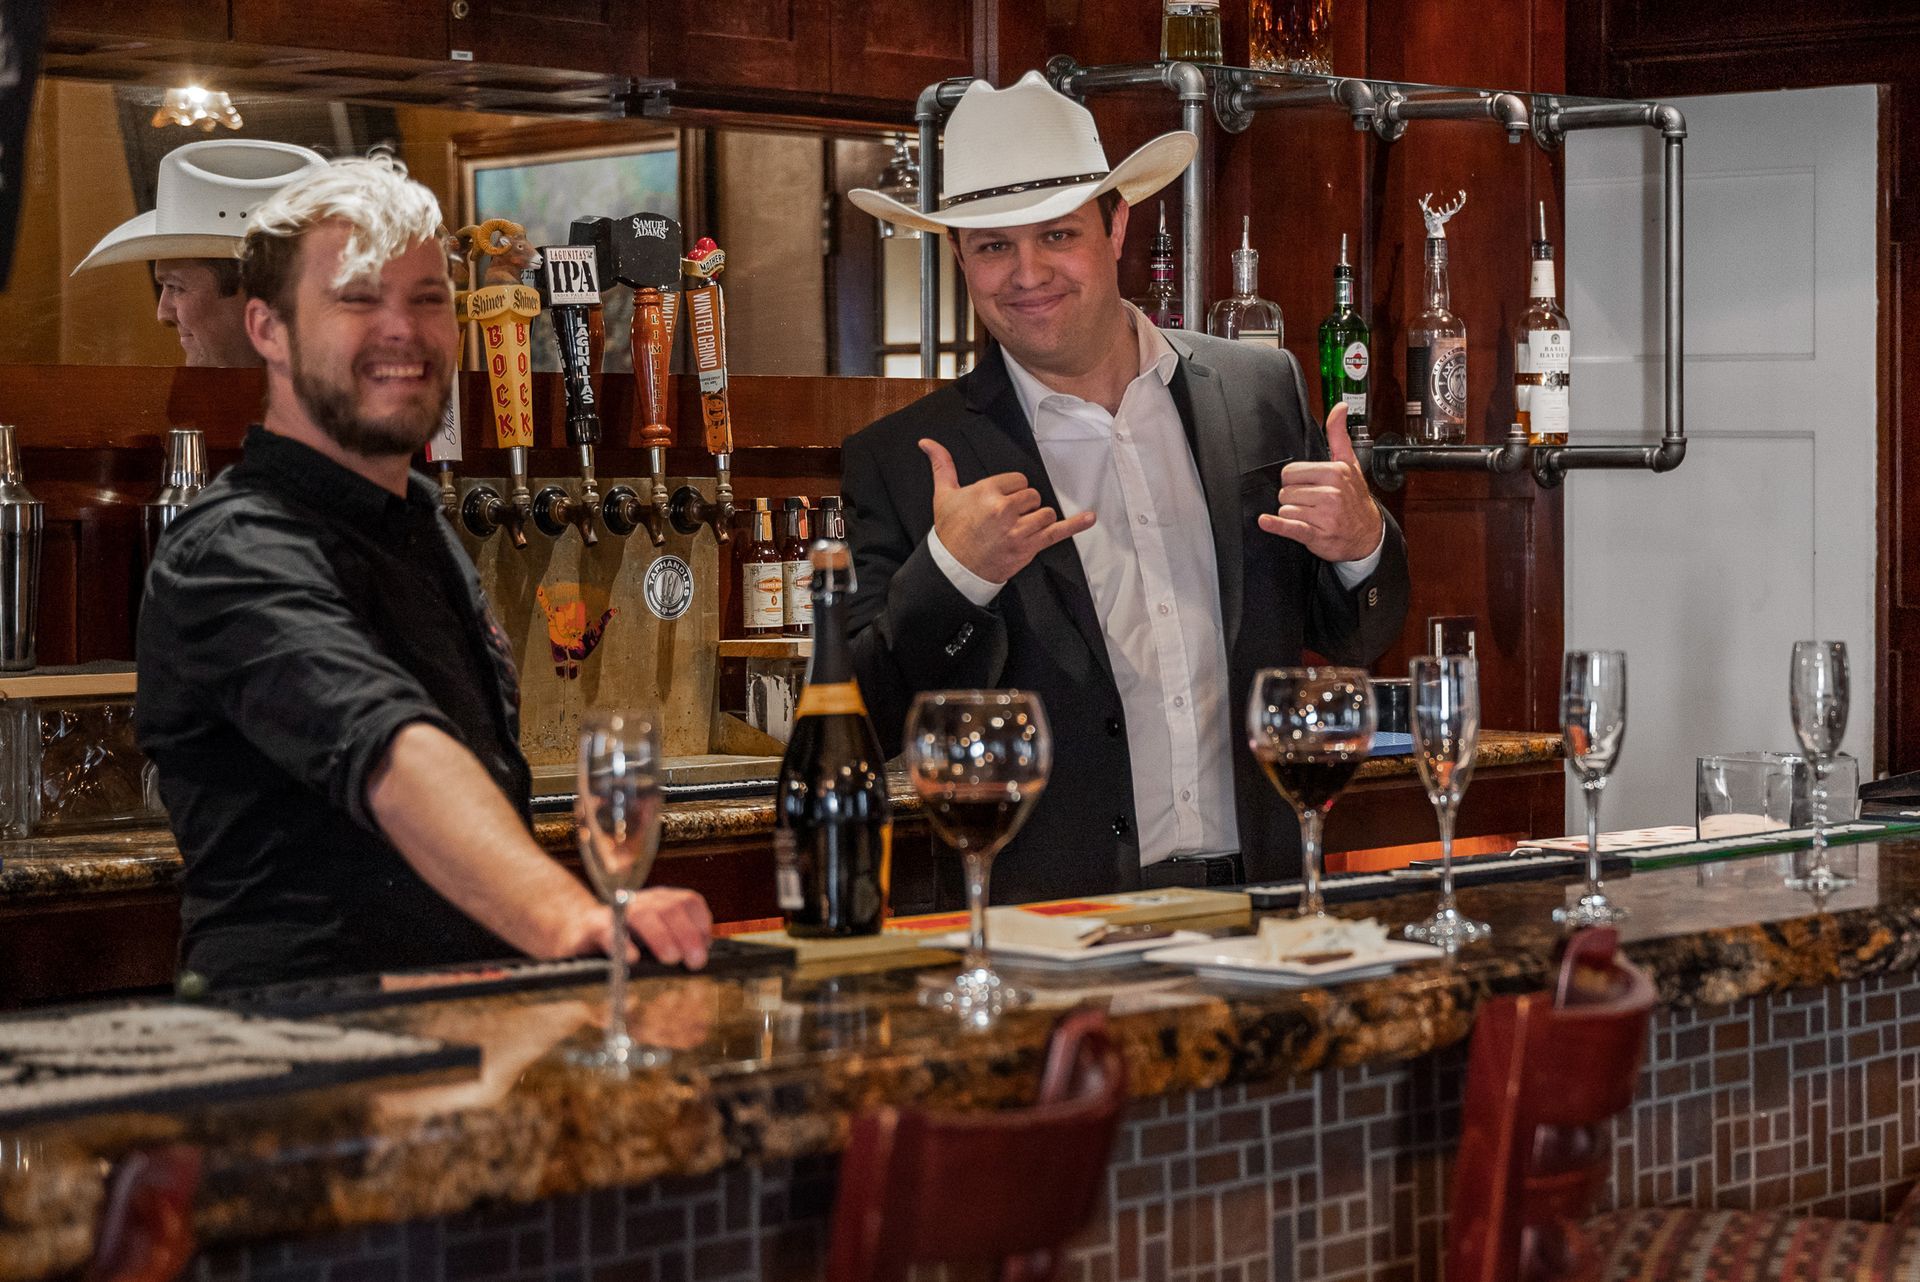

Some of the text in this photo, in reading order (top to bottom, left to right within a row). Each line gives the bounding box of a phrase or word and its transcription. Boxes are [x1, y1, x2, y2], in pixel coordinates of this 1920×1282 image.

[632, 217, 669, 231] SAMUEL
[634, 227, 667, 240] ADAMS
[550, 250, 587, 261] LAGUNITAS
[549, 260, 597, 293] IPA
[471, 293, 507, 318] Shiner
[512, 288, 539, 311] Shiner
[692, 291, 714, 334] WINTER
[574, 316, 595, 404] LAGUNITAS
[650, 313, 664, 414] LIMITED
[697, 334, 718, 369] GRIND
[486, 324, 516, 439] BOCK
[514, 321, 533, 437] BOCK
[648, 560, 691, 597] TAPHANDLES
